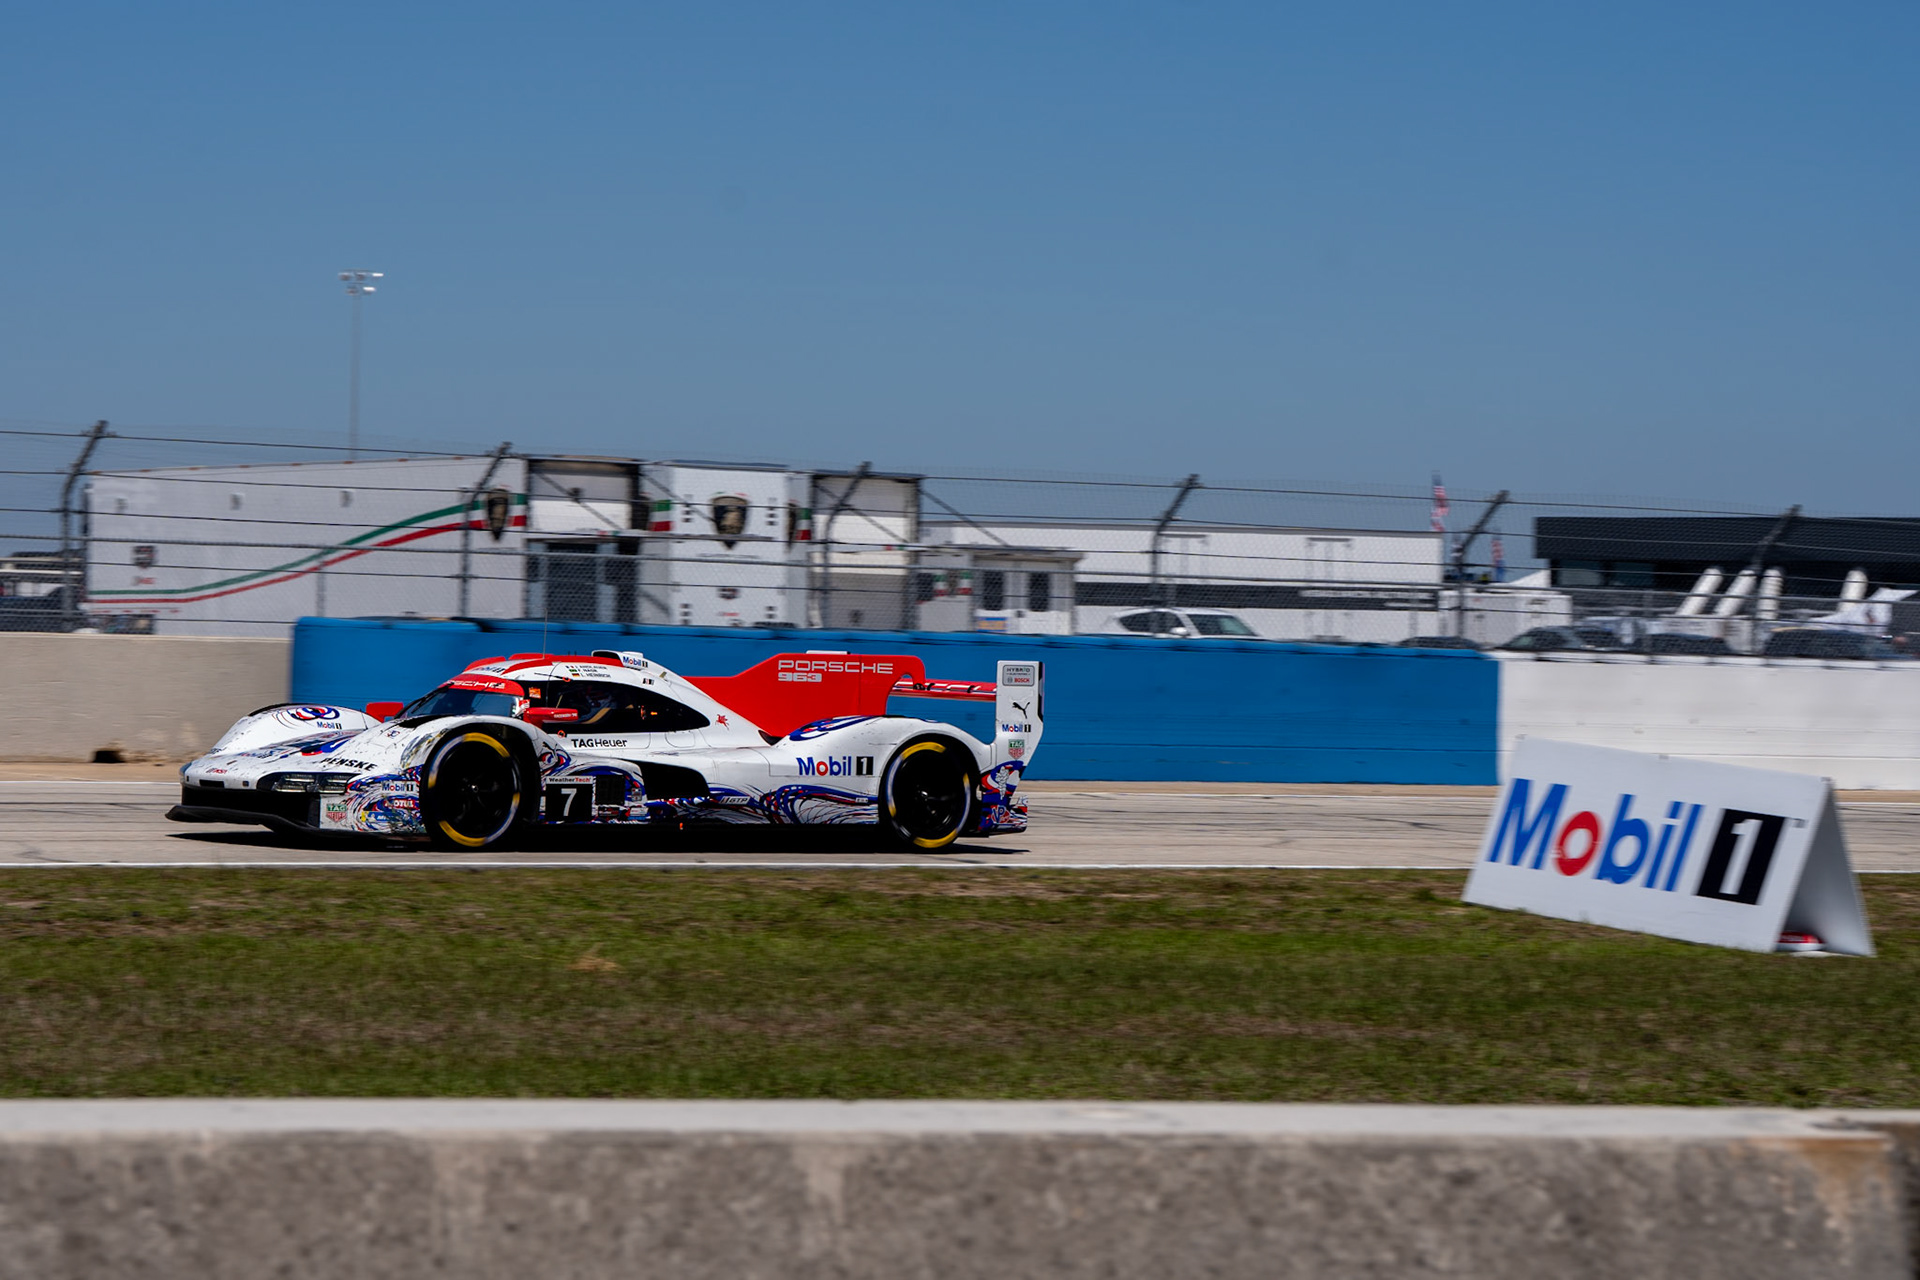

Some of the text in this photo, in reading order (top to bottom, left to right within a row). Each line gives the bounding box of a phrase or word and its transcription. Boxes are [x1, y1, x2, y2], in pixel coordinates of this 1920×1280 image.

[622, 656, 641, 666] Mobil
[778, 660, 893, 674] PORSCHE
[778, 672, 822, 682] 963
[316, 721, 335, 729] Mobil
[1002, 723, 1023, 732] Mobil
[1010, 740, 1024, 748] TAG
[320, 758, 378, 771] PENSKE
[796, 756, 851, 776] Mobil
[382, 783, 405, 791] Mobil
[561, 788, 577, 816] 7
[1487, 778, 1704, 892] Mobil
